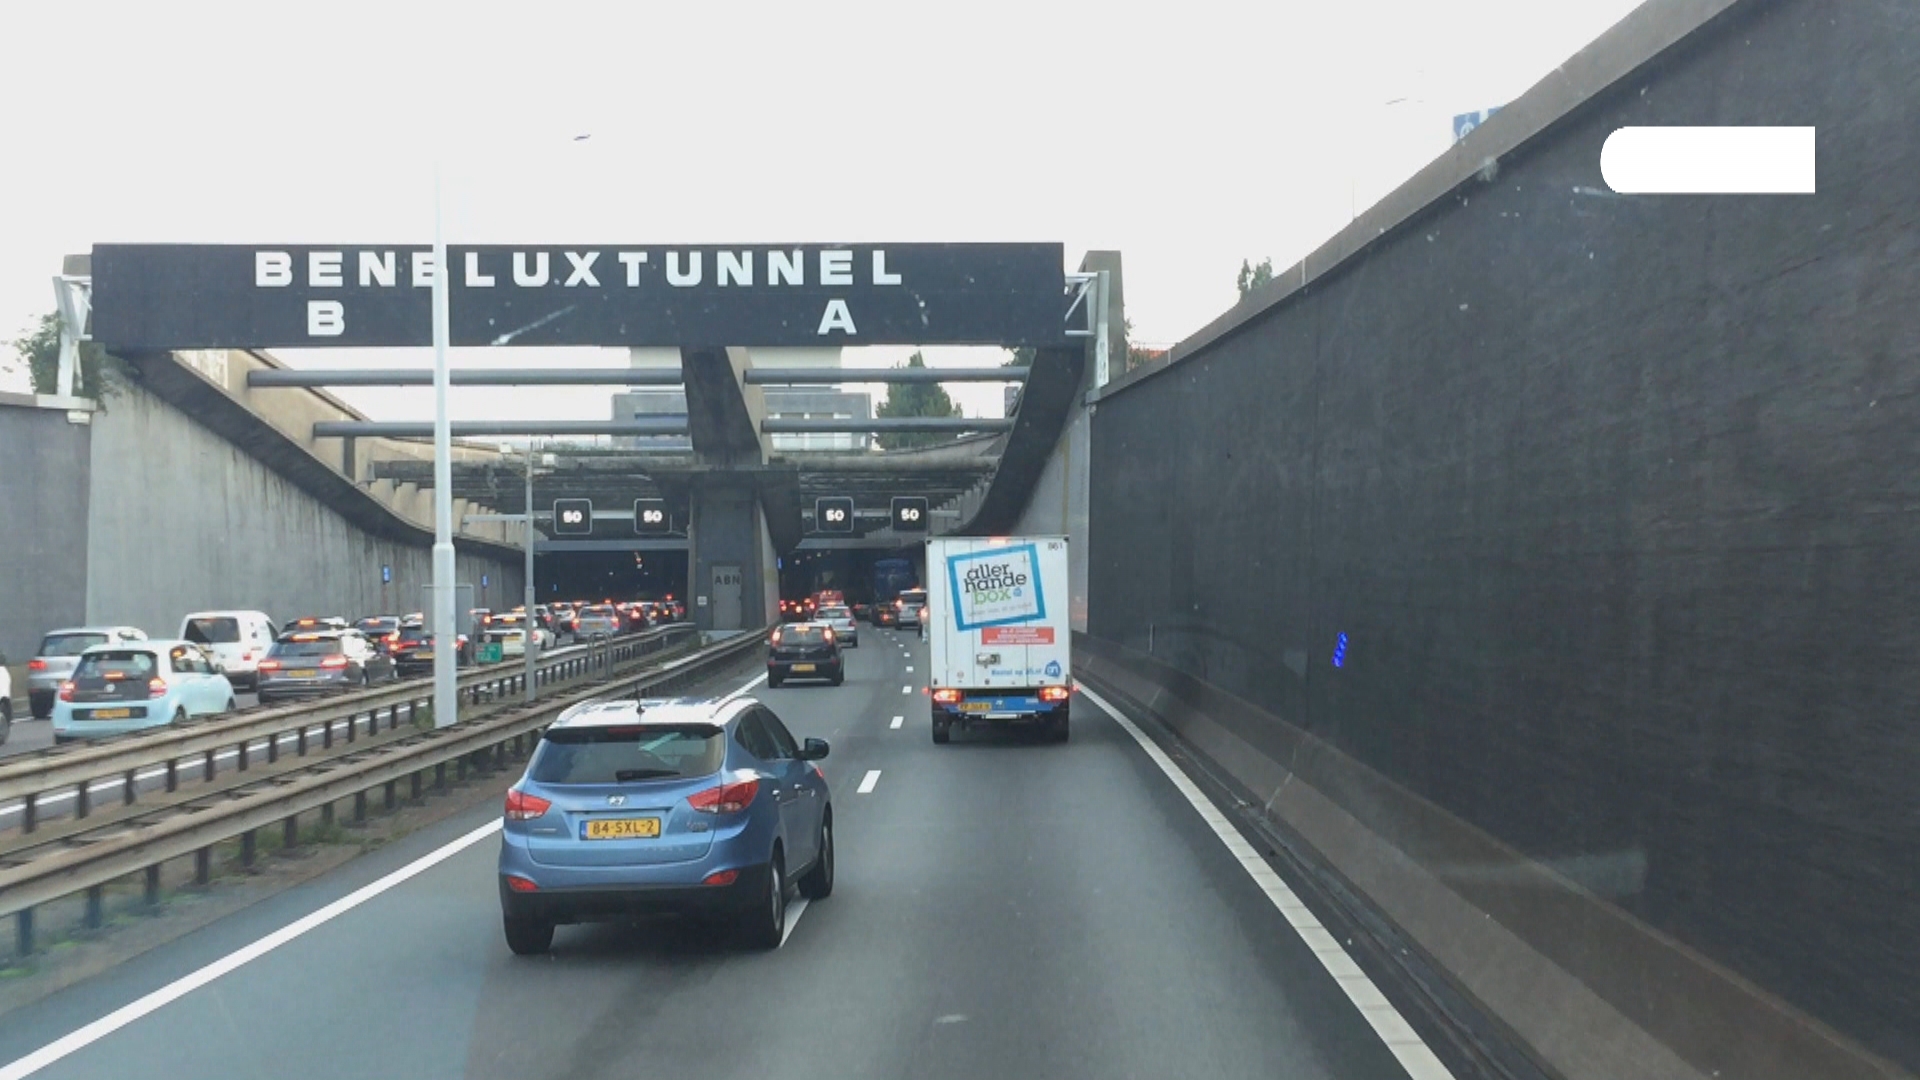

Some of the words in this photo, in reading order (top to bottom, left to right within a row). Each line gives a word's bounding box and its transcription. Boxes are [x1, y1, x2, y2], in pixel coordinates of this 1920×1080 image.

[255, 249, 902, 288] BENELUXTUNNEL
[307, 300, 345, 336] B
[818, 299, 857, 335] A
[562, 510, 583, 523] 50
[643, 509, 663, 523] 50
[825, 509, 845, 522] 50
[900, 508, 920, 521] 50
[714, 574, 741, 586] ABN
[966, 563, 1010, 581] aller
[963, 572, 1027, 593] hande
[973, 587, 1012, 605] box
[592, 820, 655, 836] 84-SXL-2
